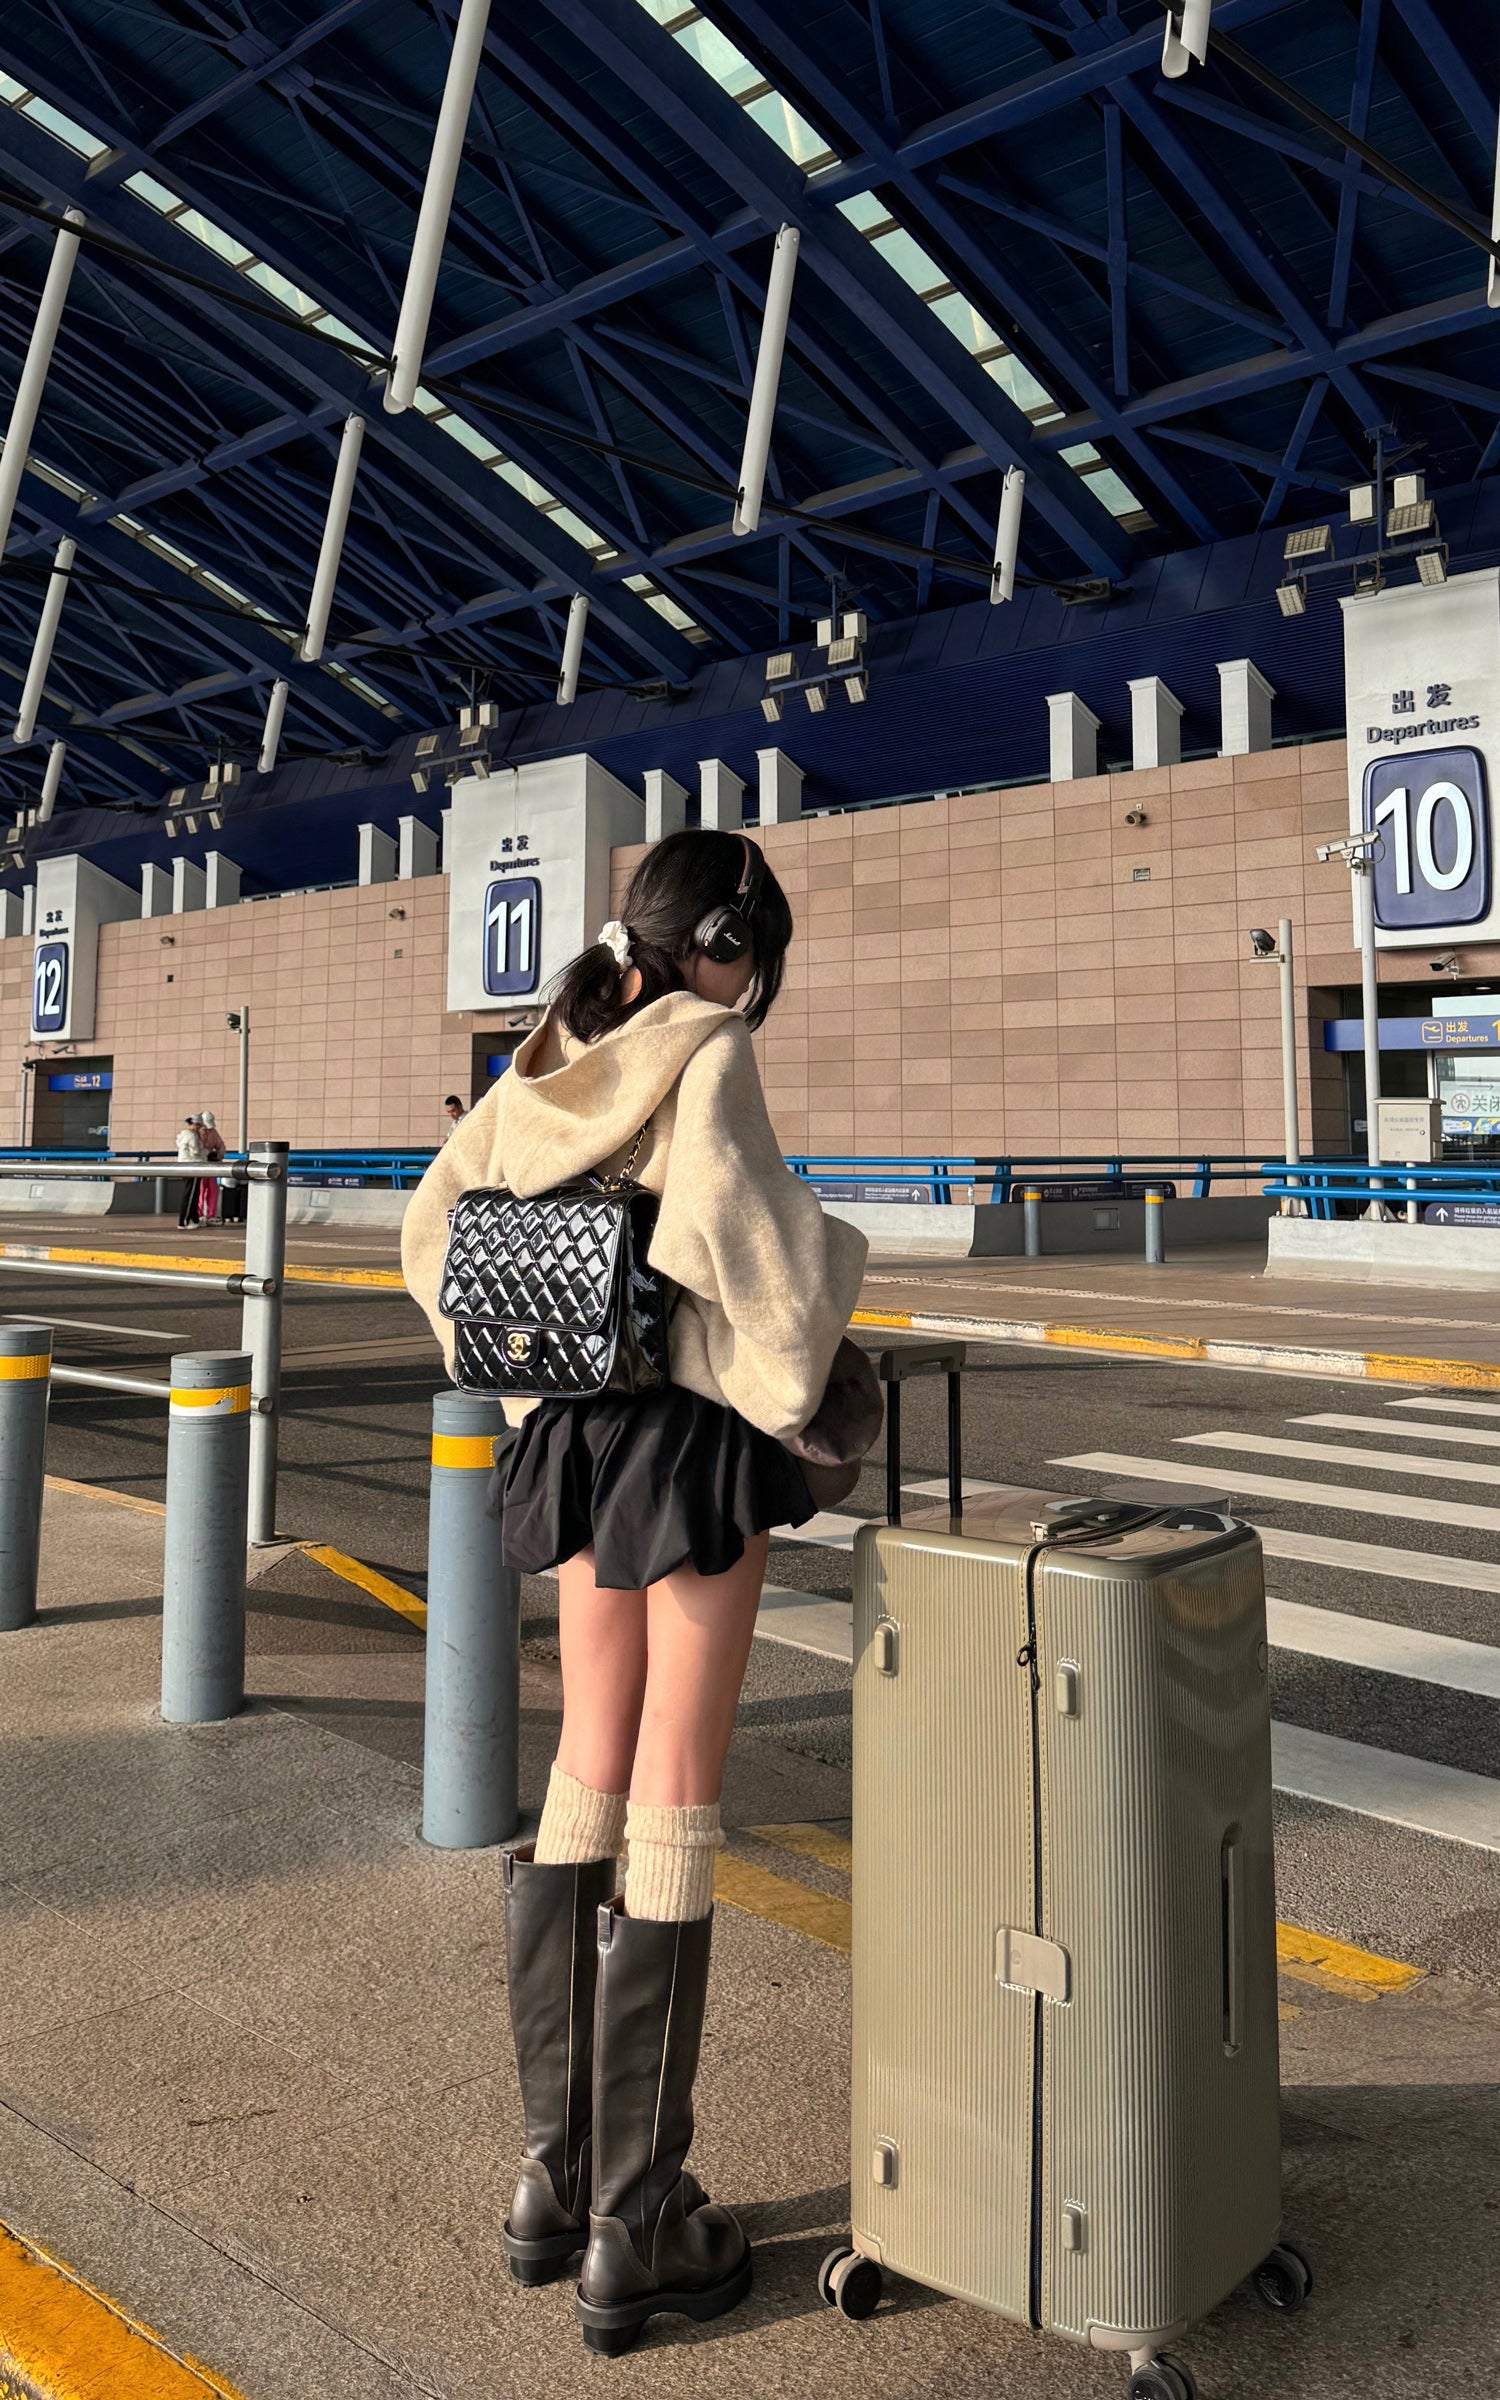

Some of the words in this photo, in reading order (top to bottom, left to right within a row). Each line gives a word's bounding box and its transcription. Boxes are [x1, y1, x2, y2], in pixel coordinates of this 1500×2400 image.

[1392, 684, 1452, 714] 出发
[1367, 714, 1480, 745] Departures
[1374, 781, 1473, 895] 10
[488, 898, 532, 974] 11
[36, 959, 61, 1017] 12
[1446, 1020, 1469, 1033] 出发
[1446, 1035, 1488, 1044] Departures
